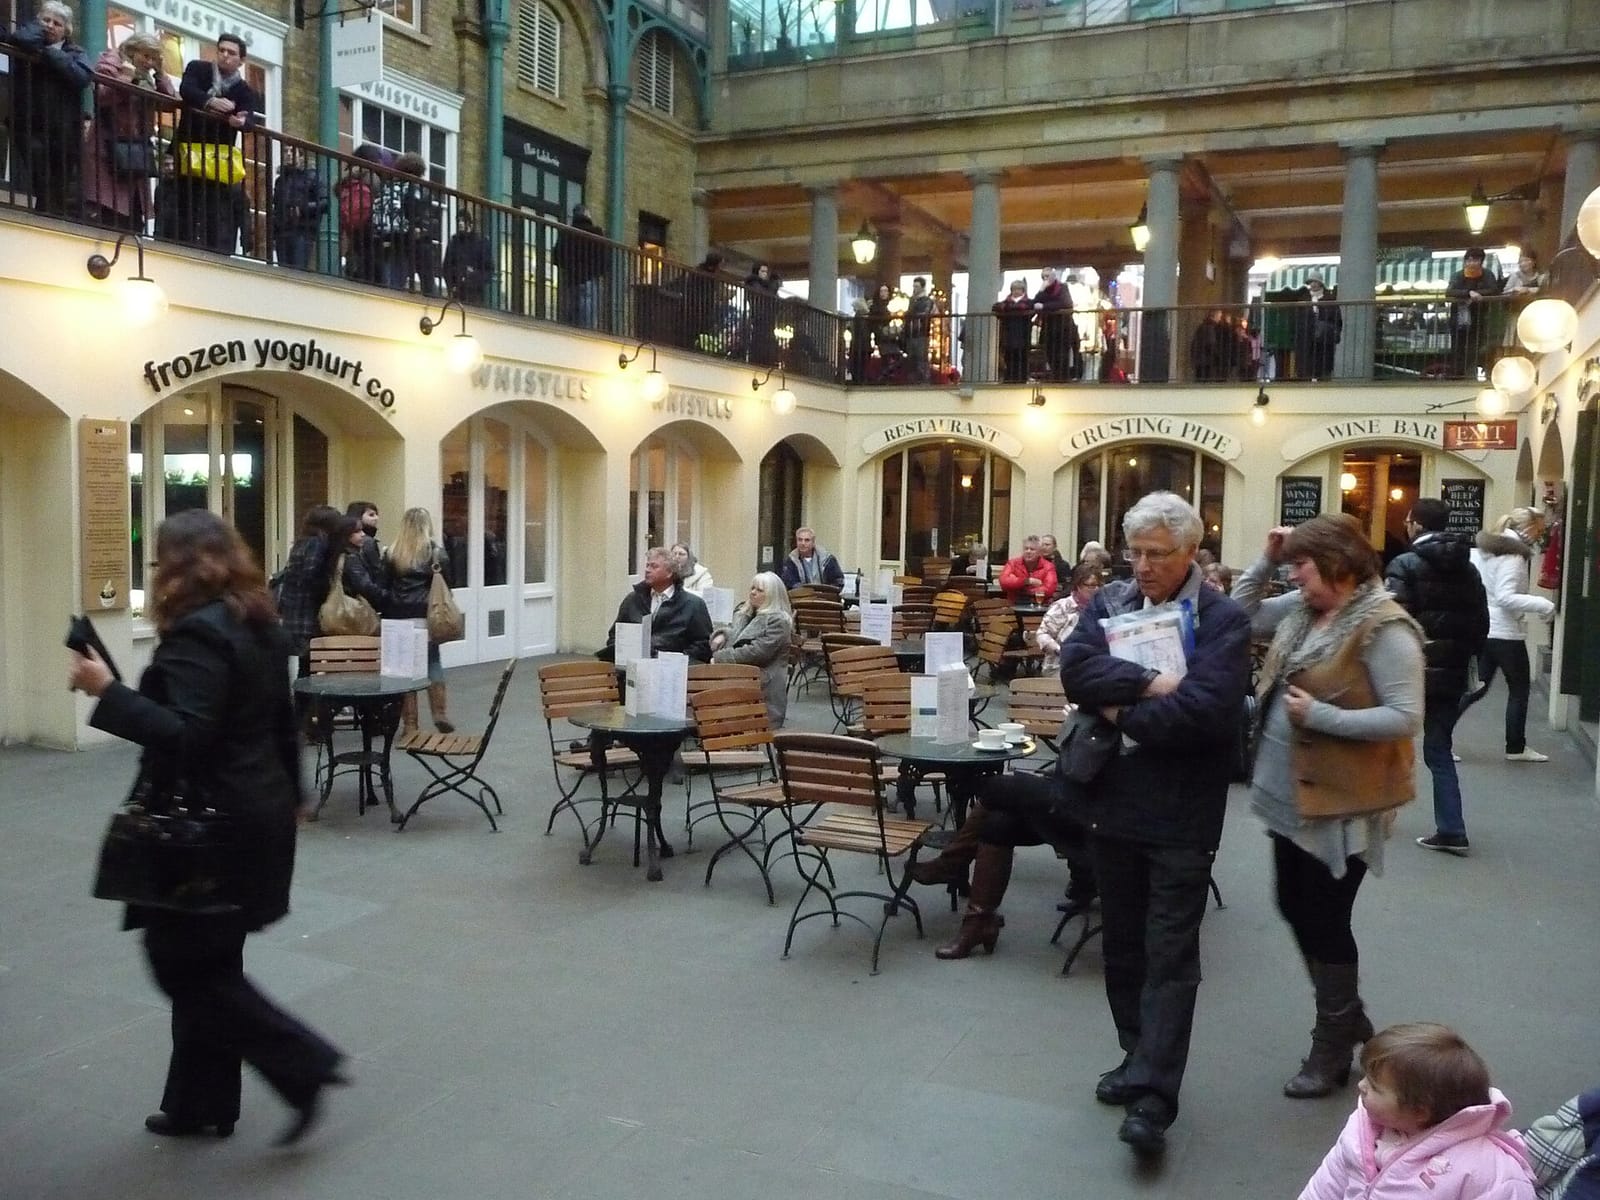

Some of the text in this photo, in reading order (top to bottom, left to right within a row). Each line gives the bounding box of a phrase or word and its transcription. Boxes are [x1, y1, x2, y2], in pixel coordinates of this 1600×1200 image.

[145, 0, 254, 47] WHISTLES
[337, 45, 376, 57] WHISTLES
[360, 81, 438, 119] WHISTLES
[144, 338, 246, 392] frozen
[254, 338, 363, 387] yoghurt
[471, 363, 592, 401] WHISTLES
[884, 418, 1000, 442] RESTAURANT
[1071, 417, 1232, 454] CRUSTING PIPE
[1326, 419, 1438, 440] WINE BAR
[1457, 425, 1506, 441] EXIT
[1285, 490, 1317, 499] WINES
[1444, 499, 1480, 508] STEAKS
[1450, 491, 1472, 500] BEEF
